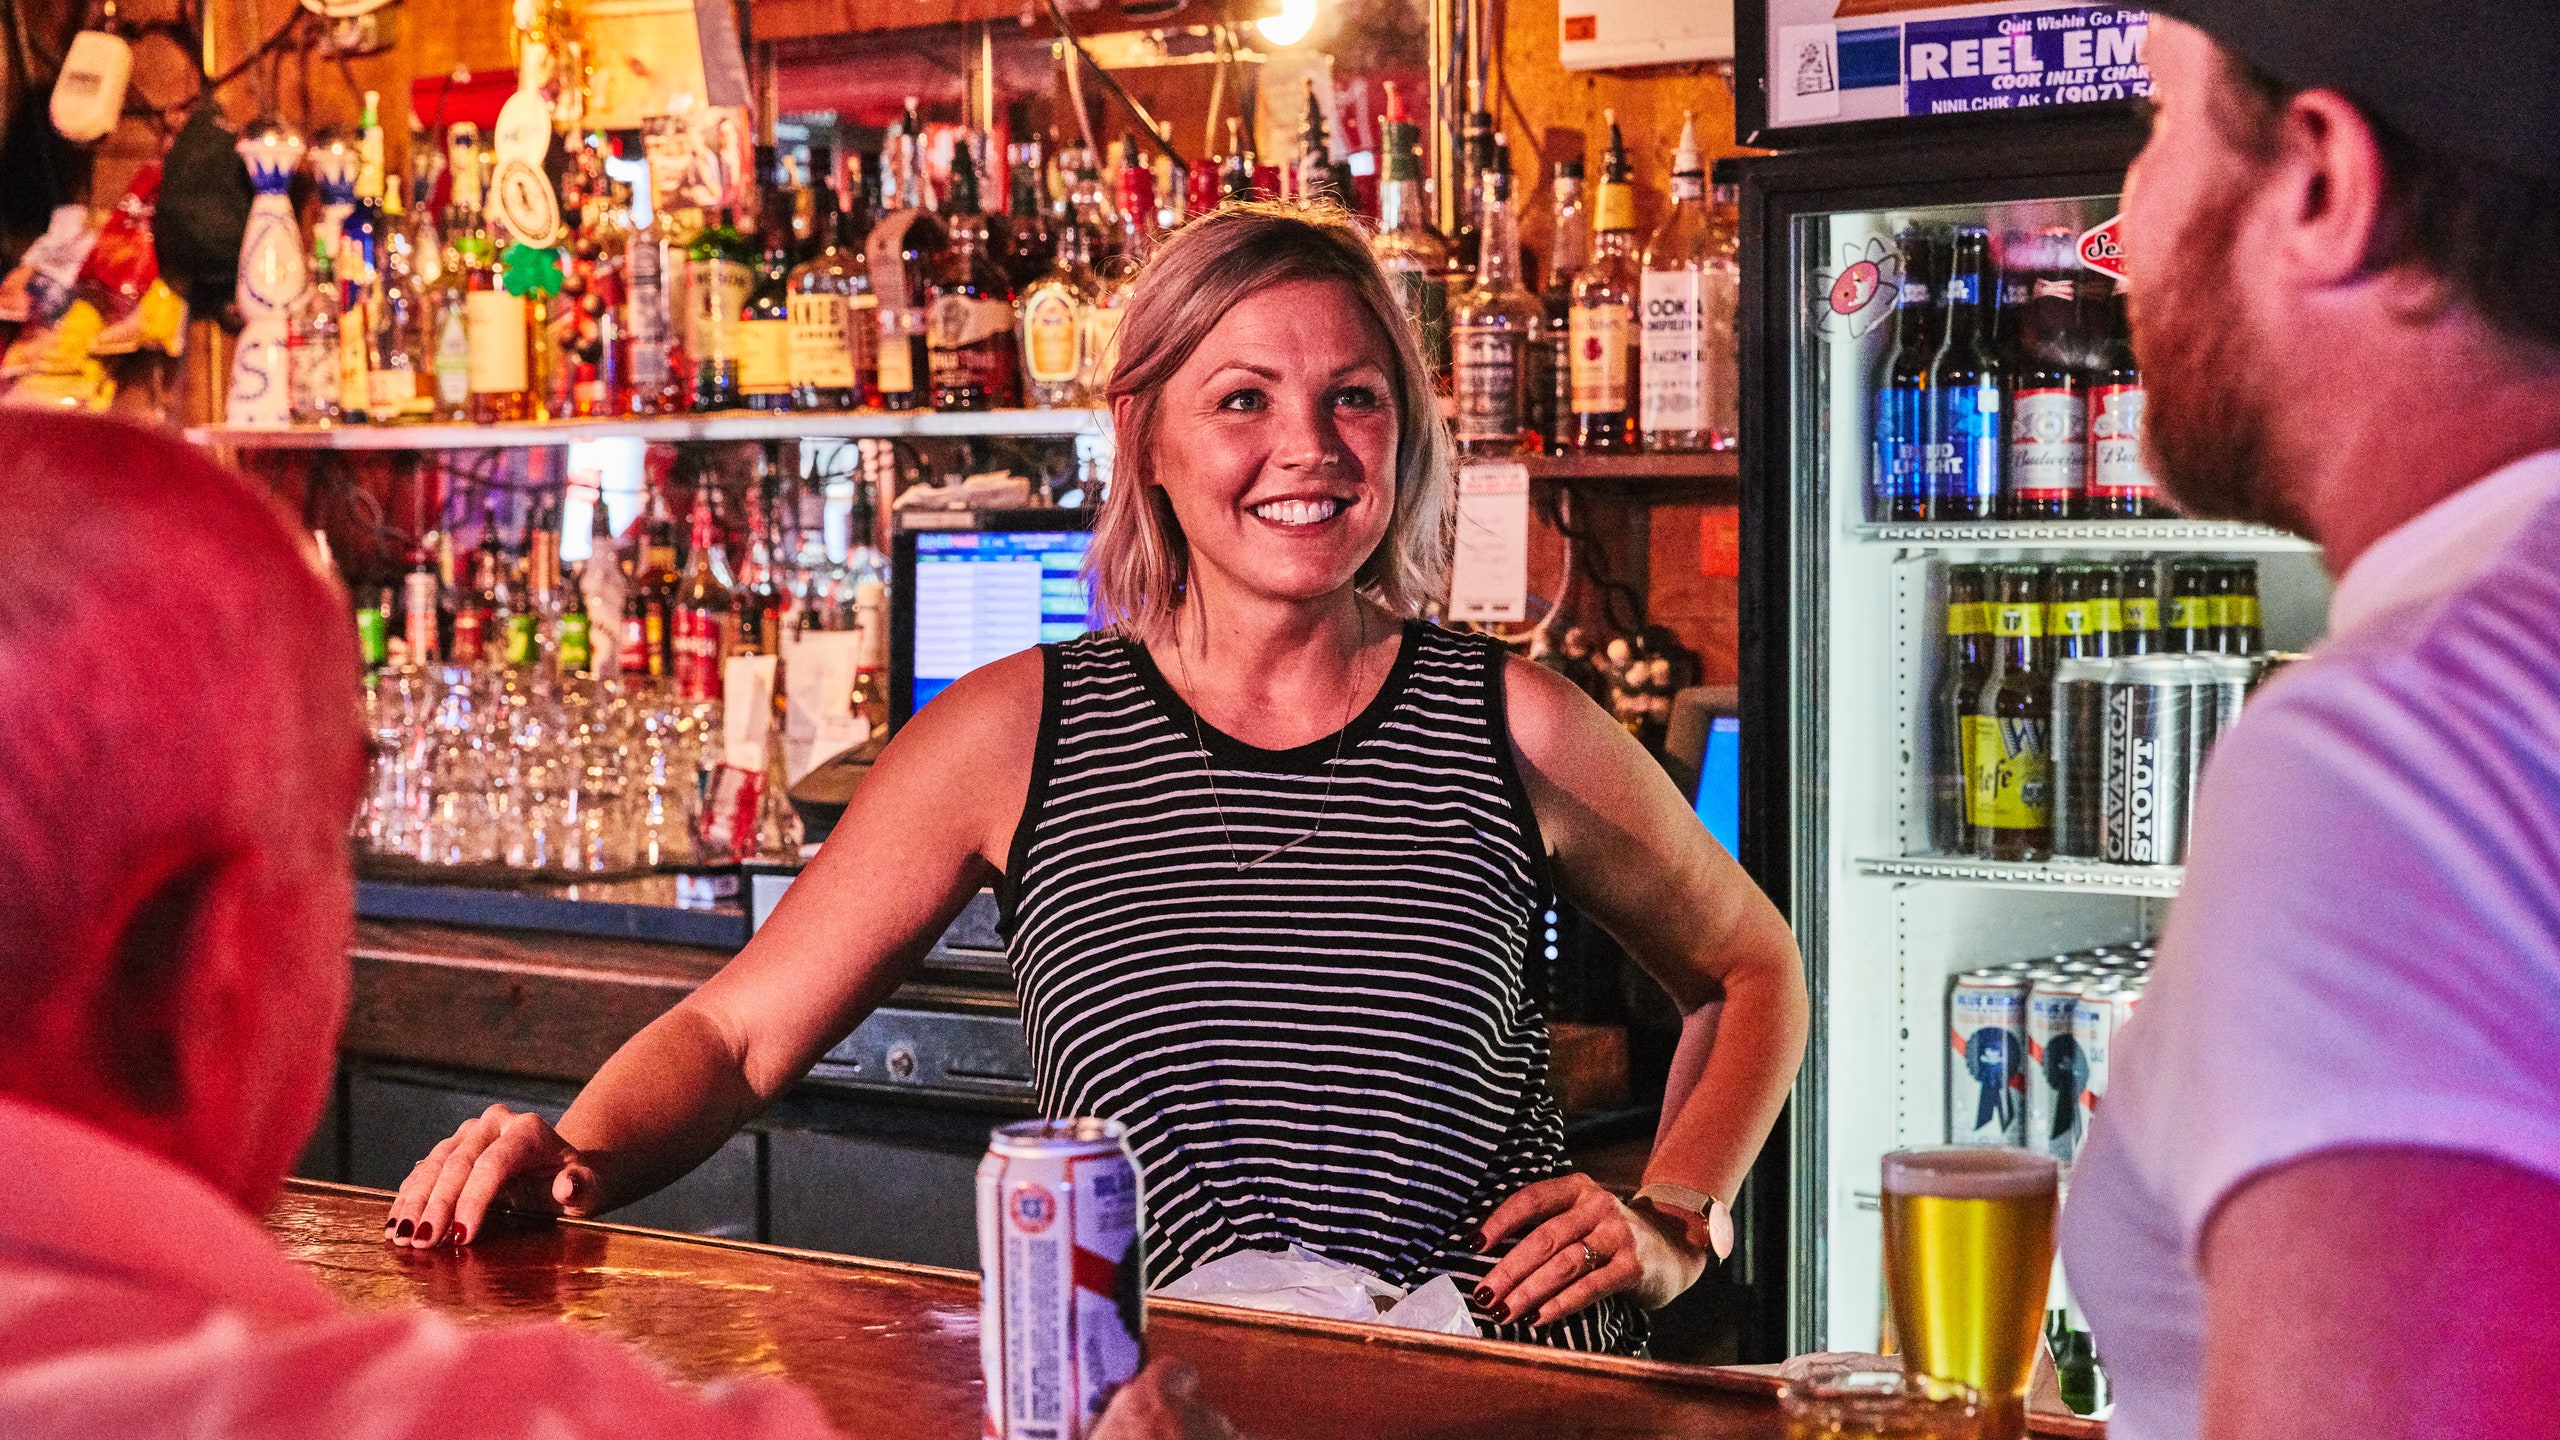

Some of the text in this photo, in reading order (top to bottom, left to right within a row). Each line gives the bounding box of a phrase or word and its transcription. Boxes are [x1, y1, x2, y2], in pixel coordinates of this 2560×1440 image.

[1998, 18, 2033, 36] Quit
[2036, 14, 2086, 32] Wishin
[2089, 11, 2113, 27] Go
[1910, 24, 2149, 82] REEL EM
[1991, 72, 2043, 91] COOK
[2046, 67, 2099, 87] INLET
[2017, 93, 2042, 108] AK
[2107, 688, 2128, 861] CAVATICA
[2131, 738, 2155, 863] STOUT
